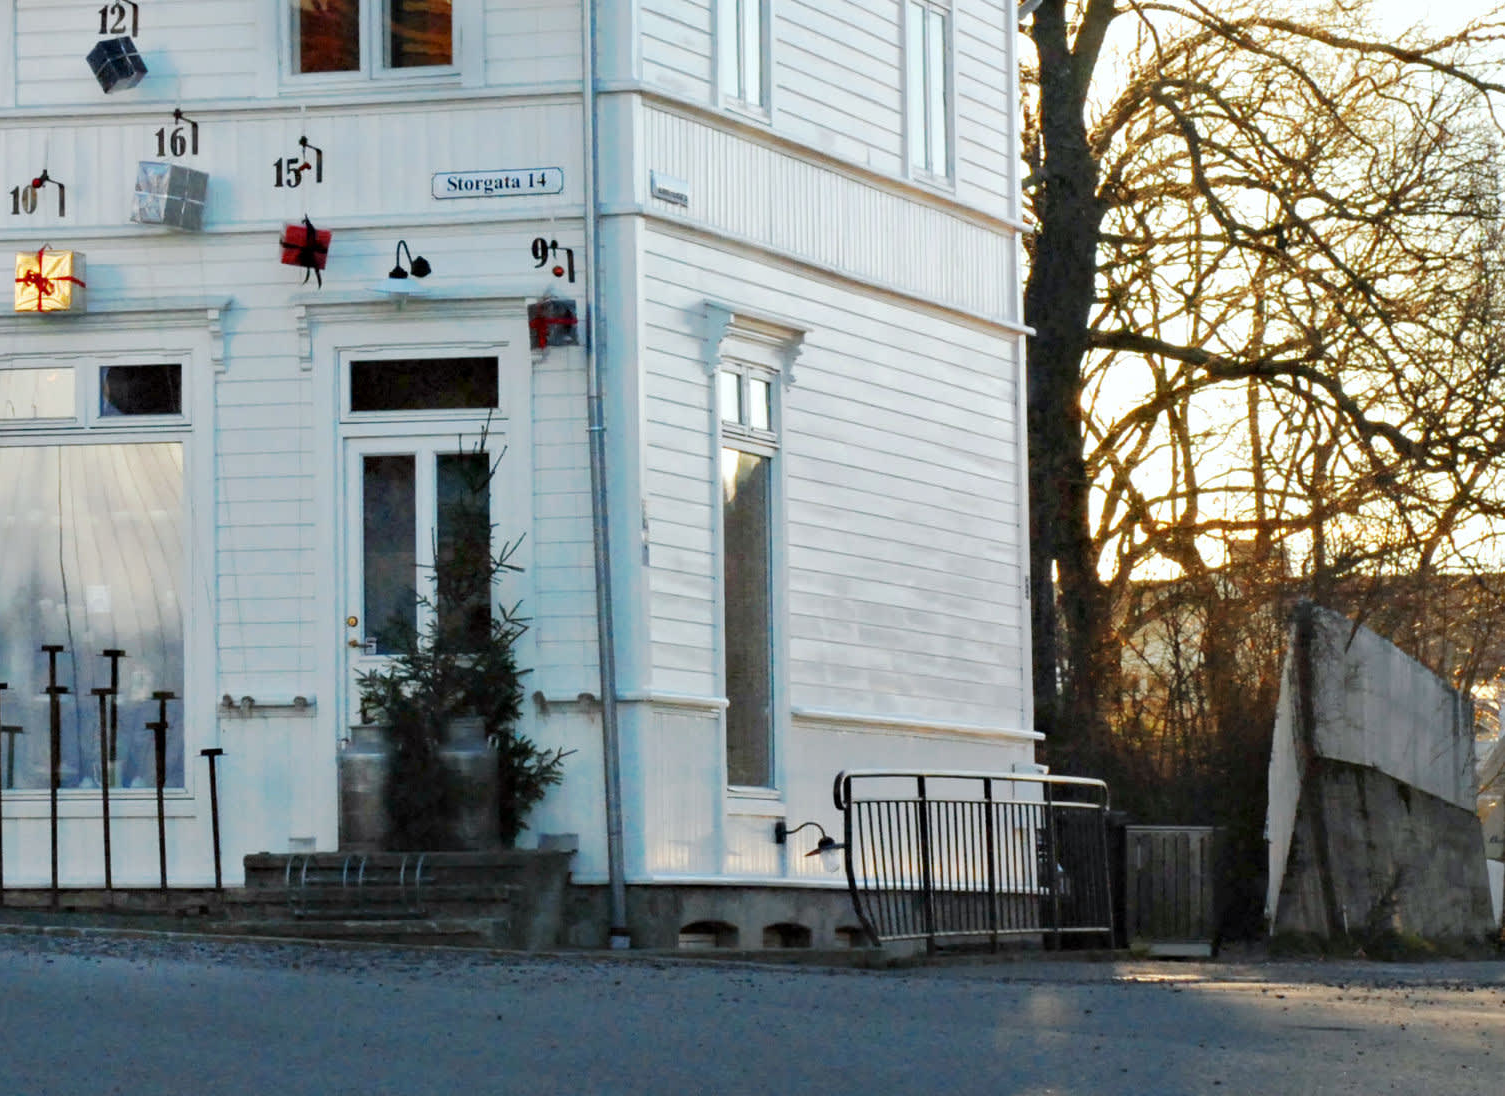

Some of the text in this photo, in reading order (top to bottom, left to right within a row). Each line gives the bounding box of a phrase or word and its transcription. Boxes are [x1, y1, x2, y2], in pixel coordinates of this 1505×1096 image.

[98, 4, 127, 35] 12
[155, 127, 186, 157] 16
[273, 158, 302, 188] 15
[447, 172, 547, 194] Storgata 14
[10, 184, 38, 215] 10
[531, 237, 549, 268] 9
